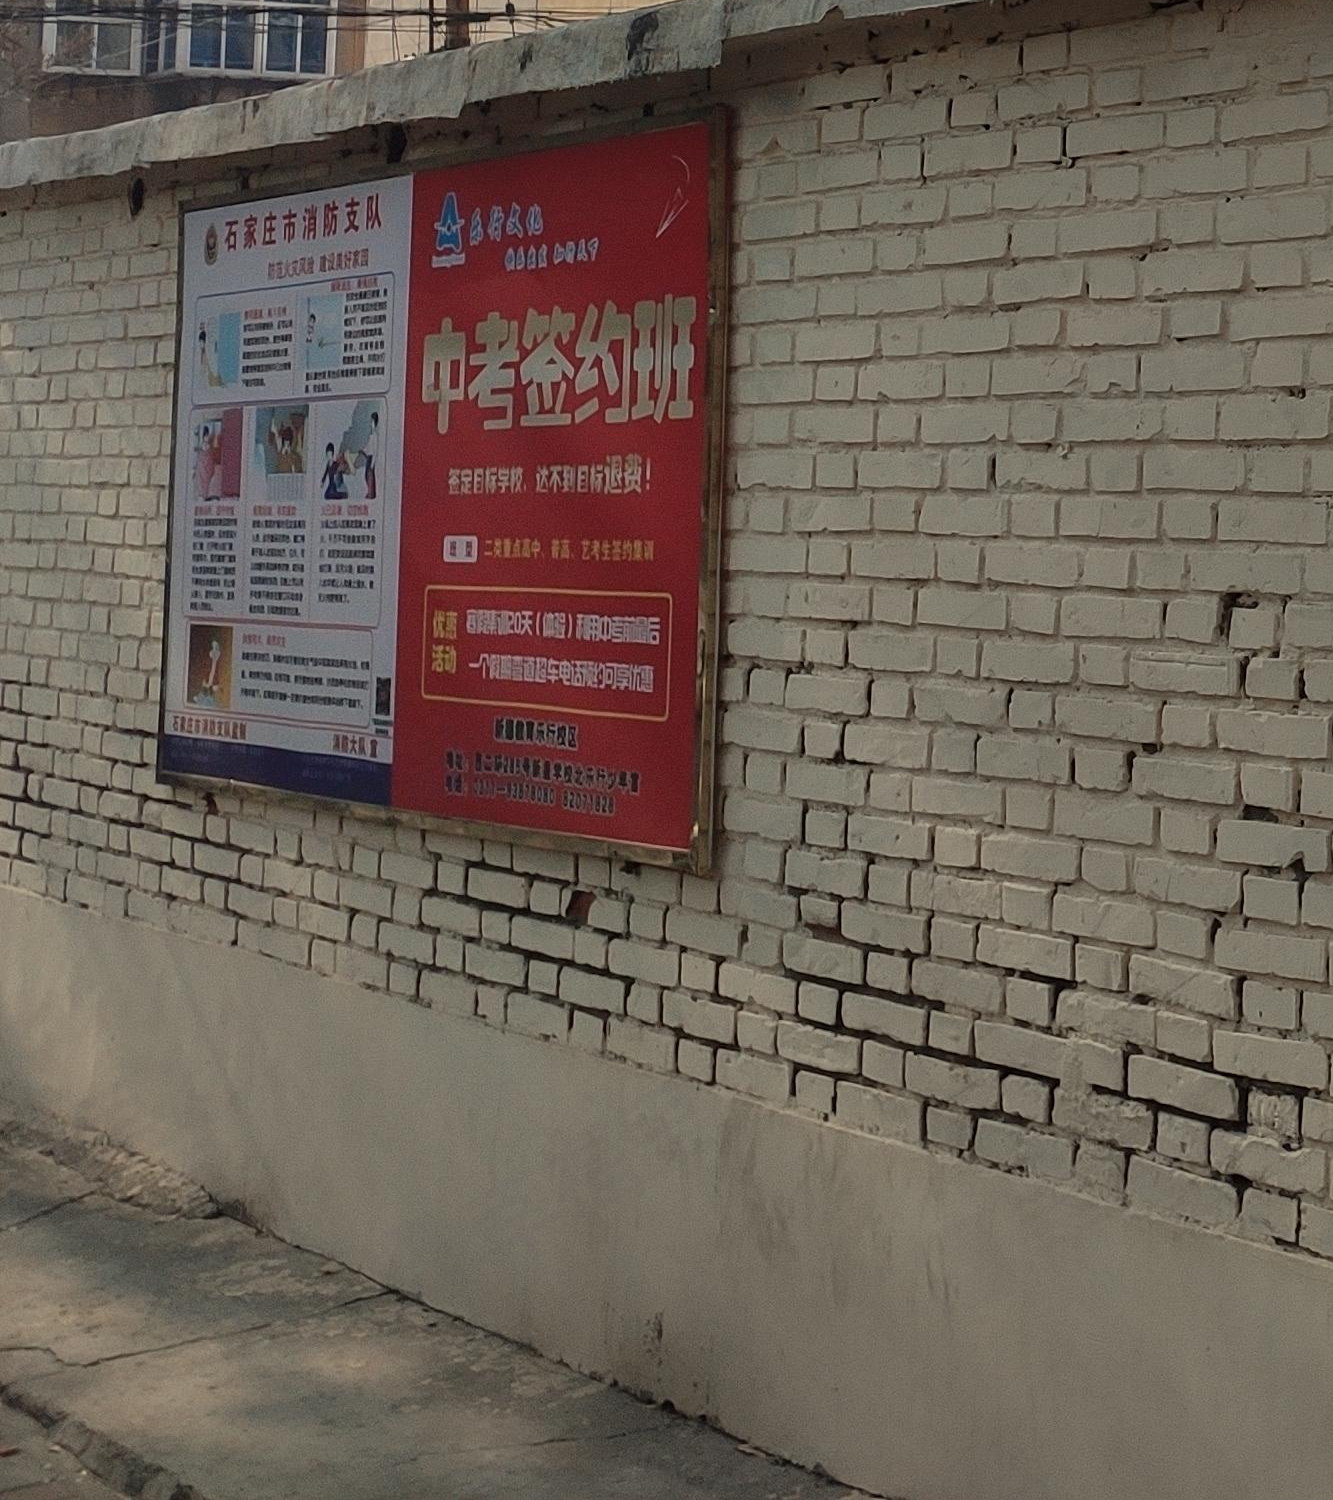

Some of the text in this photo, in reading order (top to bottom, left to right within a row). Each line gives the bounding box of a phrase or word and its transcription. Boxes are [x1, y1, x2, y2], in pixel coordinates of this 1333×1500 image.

[224, 193, 382, 252] 石家庄市消防支队
[422, 293, 697, 435] 中考签约班
[433, 611, 458, 640] 优惠
[431, 644, 457, 674] 活动
